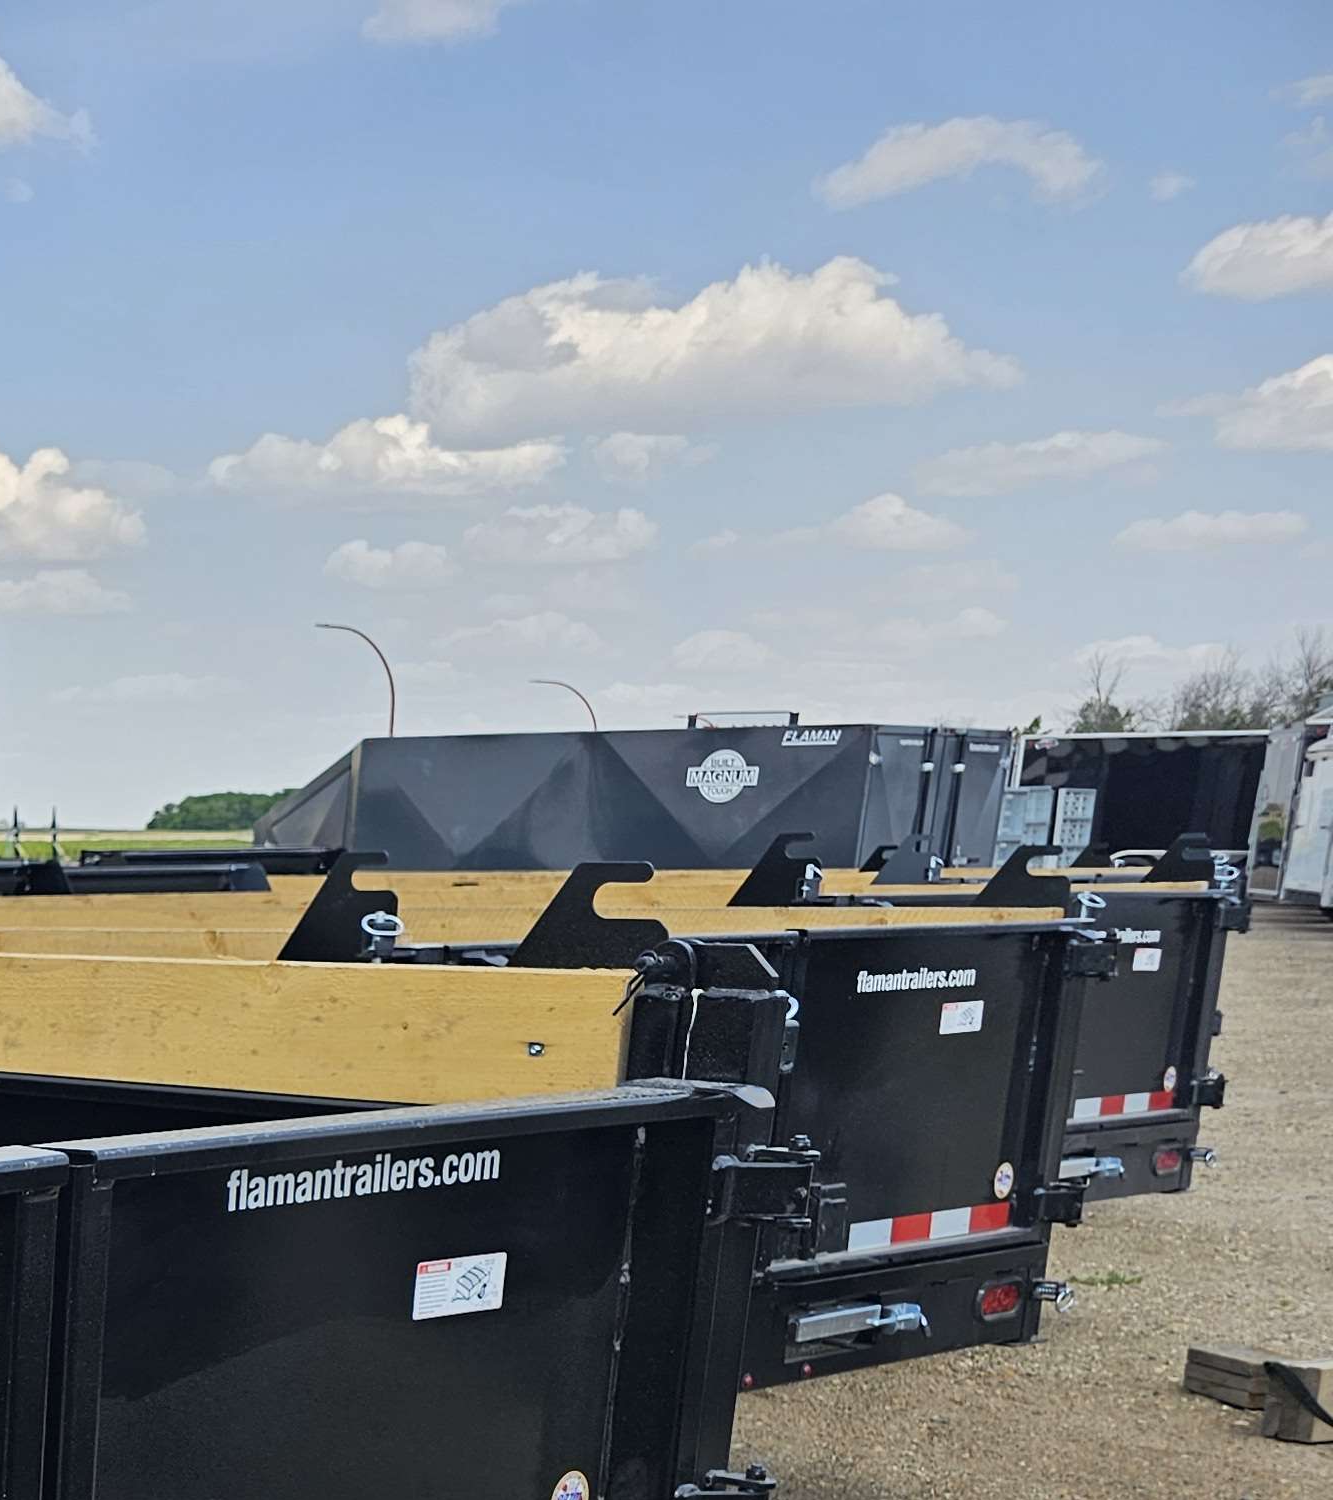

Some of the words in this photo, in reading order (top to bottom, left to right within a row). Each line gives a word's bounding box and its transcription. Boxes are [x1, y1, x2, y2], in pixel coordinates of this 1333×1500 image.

[782, 729, 841, 746] FLAMAN
[687, 768, 757, 786] MAGNUM
[856, 967, 976, 993] flamantrailers.com
[227, 1149, 501, 1212] flamantrailers.com
